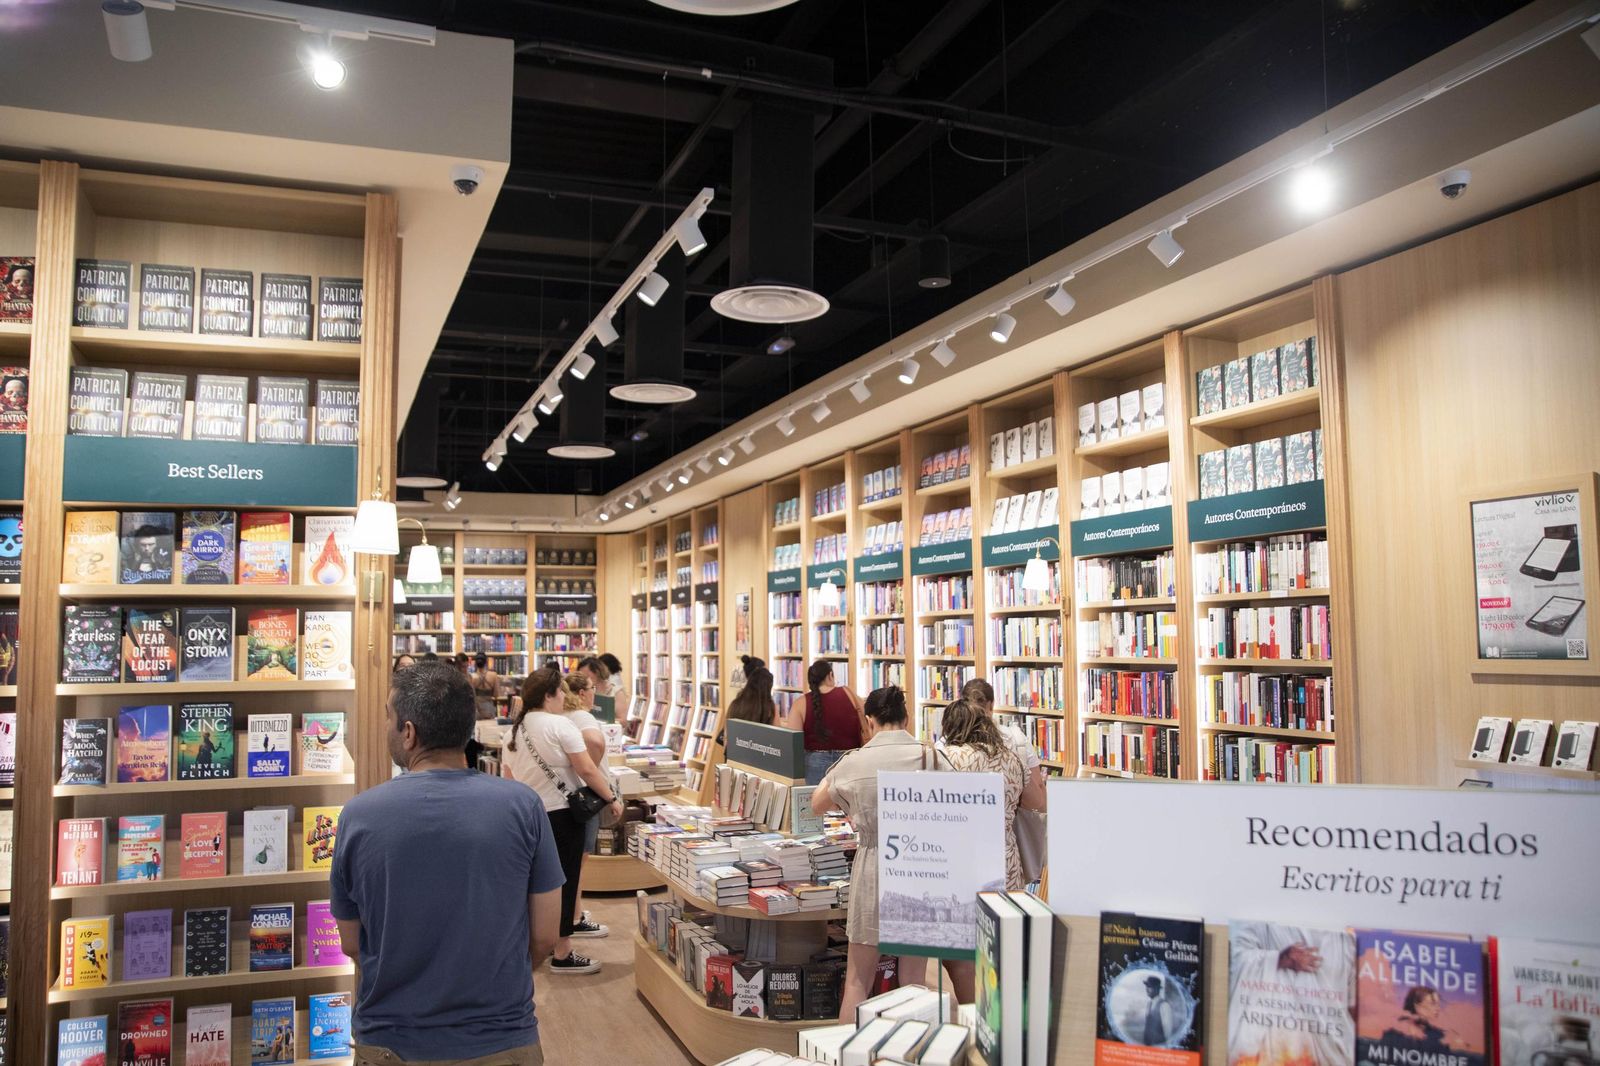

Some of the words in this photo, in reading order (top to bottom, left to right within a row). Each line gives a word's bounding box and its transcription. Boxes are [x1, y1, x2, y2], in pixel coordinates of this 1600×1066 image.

[80, 269, 126, 286] PATRICIA
[145, 274, 189, 291] PATRICIA
[205, 279, 249, 296] PATRICIA
[77, 287, 127, 304] CORNWELL
[142, 292, 191, 309] CORNWELL
[203, 296, 249, 312] CORNWELL
[78, 307, 125, 323] QUANTUM
[143, 311, 188, 327] QUANTUM
[203, 315, 248, 332] QUANTUM
[74, 377, 120, 394] PATRICIA
[70, 395, 121, 412] CORNWELL
[70, 415, 118, 432] QUANTUM
[167, 463, 205, 479] Best
[207, 464, 264, 481] Sellers
[1535, 495, 1565, 507] vivlio
[1204, 512, 1234, 524] Autores
[1234, 501, 1306, 520] Contemporáneos
[1083, 531, 1106, 541] Autores
[1106, 522, 1160, 538] Contemporáneos
[197, 539, 219, 547] DARK
[991, 545, 1009, 555] Autores
[259, 620, 288, 629] BONES
[305, 614, 325, 622] HAN
[141, 620, 162, 632] THE
[69, 628, 115, 645] fearless
[138, 633, 165, 645] YEAR
[188, 628, 227, 641] ONYX
[254, 629, 291, 638] BENEATH
[132, 646, 145, 658] OF
[150, 646, 170, 658] THE
[186, 646, 228, 658] STORM
[305, 652, 319, 660] DO
[131, 659, 171, 671] LOCUST
[305, 670, 329, 678] PART
[181, 707, 232, 718] STEPHEN
[185, 718, 227, 732] KING
[250, 719, 288, 732] INTERMEZZO
[74, 742, 98, 750] MOON
[68, 749, 103, 757] HATCHED
[132, 754, 155, 762] Taylor
[121, 761, 149, 769] Jenkins
[150, 761, 167, 769] Reid
[182, 769, 229, 778] FLINCH
[882, 787, 923, 803] Hola
[927, 788, 997, 806] Almería
[882, 811, 898, 821] Del
[899, 813, 909, 824] 19
[909, 811, 918, 821] al
[919, 813, 930, 822] 26
[931, 812, 942, 822] de
[942, 813, 969, 824] Junio
[253, 824, 277, 832] KING
[252, 837, 277, 845] ENVY
[1245, 816, 1539, 858] Recomendados
[885, 834, 919, 860] 5%
[922, 842, 945, 854] Dto.
[184, 850, 224, 858] DECEPTION
[62, 870, 98, 884] TENANT
[885, 867, 906, 880] ¡Ven
[907, 871, 913, 879] a
[914, 870, 949, 881] vernos!
[1280, 864, 1394, 894] Escritos
[1398, 874, 1472, 904] para
[1480, 873, 1504, 902] ti
[253, 913, 289, 922] MICHAEL
[251, 920, 292, 929] CONNELLY
[1113, 924, 1136, 936] Nada
[1139, 926, 1166, 938] bueno
[80, 931, 100, 939] バター
[1103, 935, 1140, 947] germina
[1142, 937, 1169, 950] César
[1172, 939, 1198, 952] Pérez
[65, 927, 74, 985] BUTTER
[1164, 950, 1199, 963] Gellida
[1373, 937, 1462, 969] ISABEL
[771, 973, 796, 982] DOLORES
[1358, 963, 1478, 993] ALLENDE
[1513, 964, 1563, 982] VANESSA
[743, 983, 759, 991] MEJOR
[769, 981, 799, 991] REDONDO
[1239, 978, 1292, 997] MARCOS
[1294, 984, 1345, 1003] CHICOT
[1514, 988, 1545, 1008] La
[1240, 992, 1254, 1005] EL
[1256, 995, 1323, 1016] ASESINATO
[1326, 1005, 1343, 1018] DE
[67, 1021, 98, 1031] COLLEEN
[253, 1018, 275, 1029] ROAD
[1239, 1008, 1344, 1038] ARISTÓTELES
[61, 1030, 104, 1044] HOOVER
[121, 1031, 168, 1041] DROWNED
[191, 1030, 225, 1043] HATE
[254, 1029, 273, 1038] TRIP
[60, 1046, 105, 1059] NOVEMBER
[1367, 1044, 1387, 1058] MI
[1391, 1046, 1468, 1066] NOMBRE
